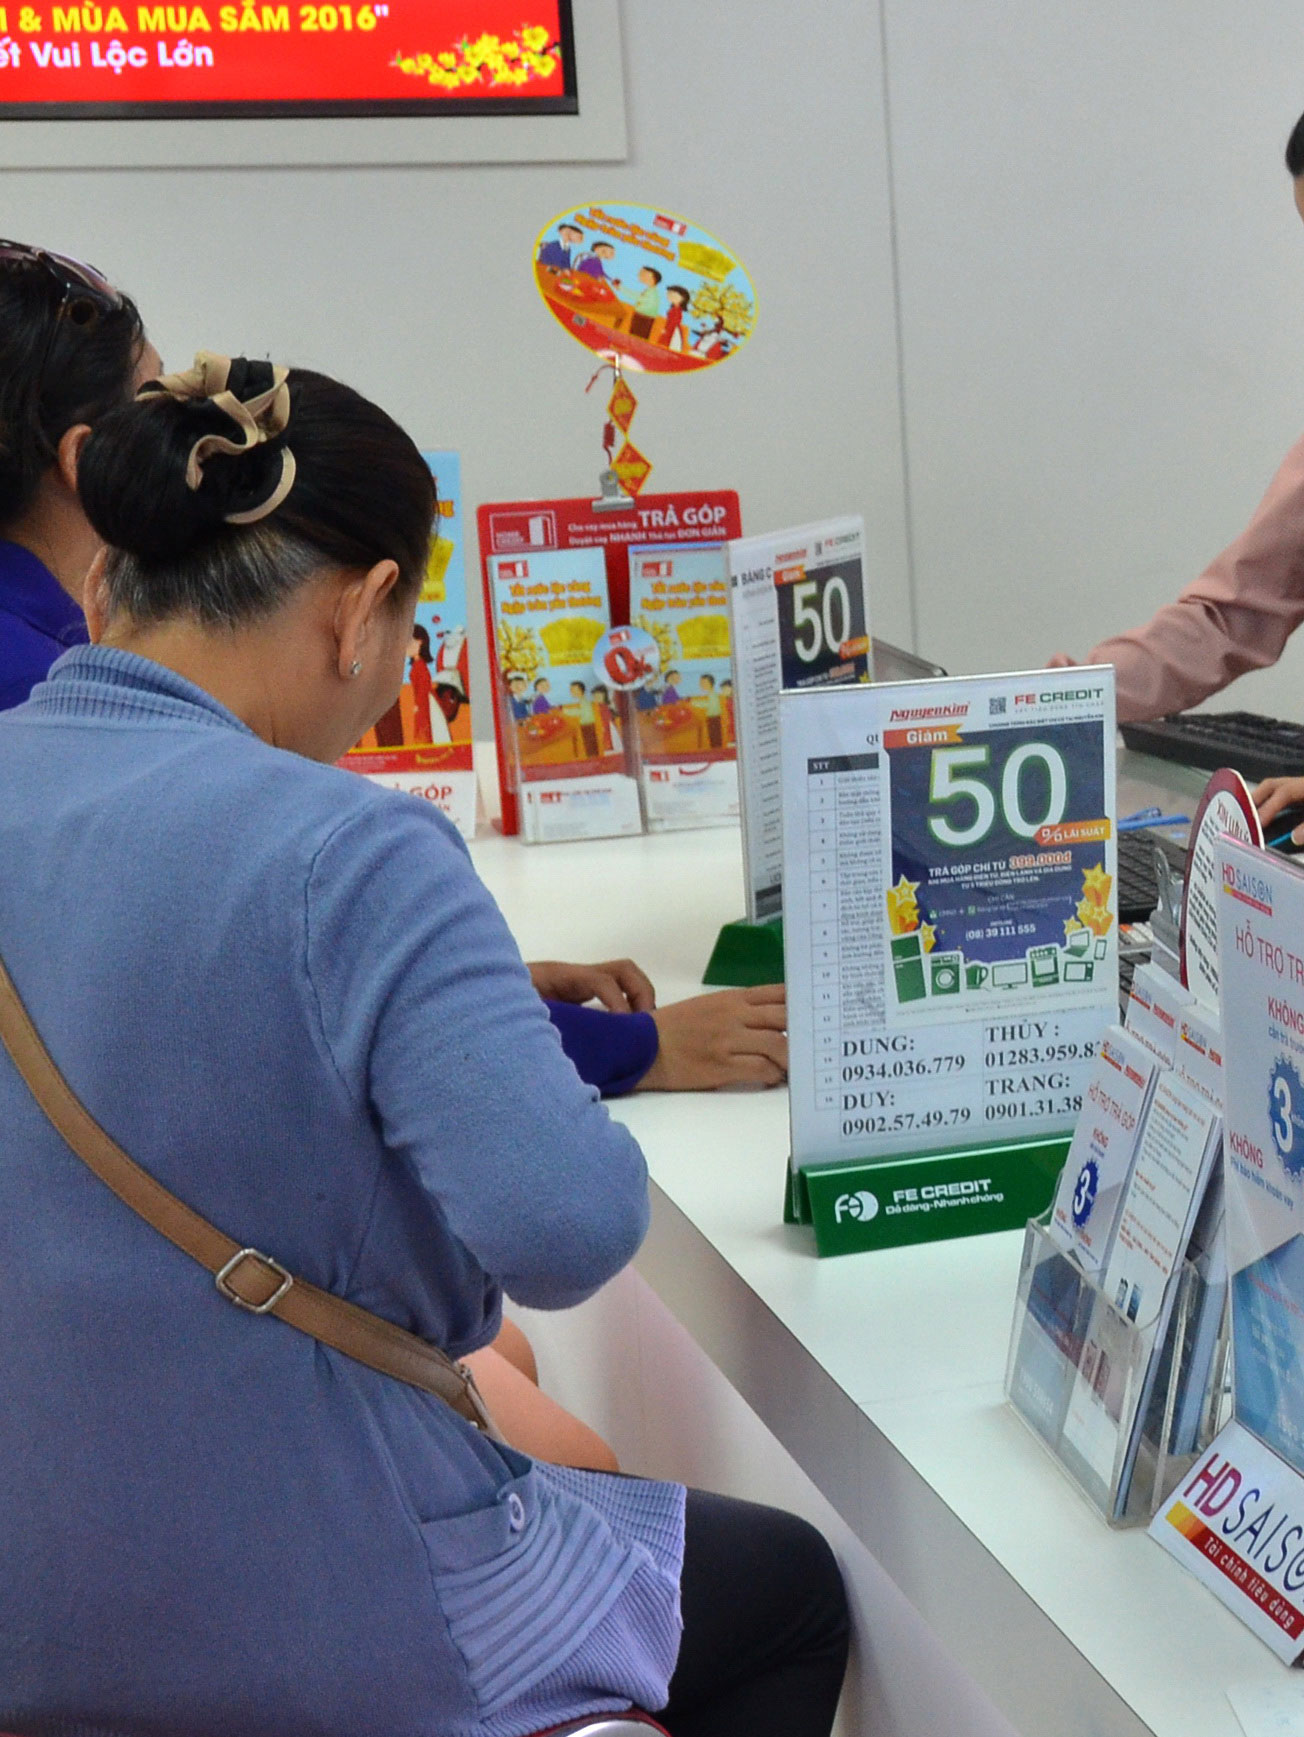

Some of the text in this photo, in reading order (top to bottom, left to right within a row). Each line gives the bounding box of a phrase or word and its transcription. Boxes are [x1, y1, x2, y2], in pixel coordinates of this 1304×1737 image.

[19, 7, 42, 32] &
[52, 0, 128, 32] MÙA
[137, 6, 211, 32] MUA
[29, 38, 214, 75] Vui Lộc Lớn
[638, 504, 679, 528] TRẢ
[683, 503, 726, 525] GÓP
[792, 576, 851, 663] 50
[1015, 688, 1104, 706] FE CREDIT
[890, 701, 970, 722] NguyenKim
[906, 729, 948, 745] Giảm
[929, 742, 1067, 847] 50
[1064, 829, 1079, 840] LÃI
[1080, 826, 1106, 837] SUẤT
[928, 866, 949, 878] TRẢ
[951, 863, 971, 877] GÓP
[1222, 862, 1236, 887] HD
[1237, 868, 1273, 904] SAISON
[1000, 926, 1015, 936] 111
[1236, 919, 1254, 959] HỖ
[1257, 937, 1284, 979] TRỢ
[1268, 996, 1304, 1035] KHÔNG
[986, 1018, 1048, 1043] THỦY
[843, 1036, 914, 1056] DUNG:
[843, 1055, 965, 1082] 0934.036.779
[986, 1072, 1070, 1096] TRANG:
[843, 1090, 895, 1111] DUY:
[985, 1096, 1083, 1121] 0901.31.38
[843, 1107, 971, 1136] 0902.57.49.79
[1274, 1076, 1294, 1153] 3
[1229, 1129, 1264, 1169] KHÔNG
[893, 1178, 992, 1203] FE CREDIT
[1074, 1169, 1091, 1215] 3
[1183, 1453, 1242, 1517] HD
[1204, 1536, 1296, 1630] Tài chính tiêu dùng
